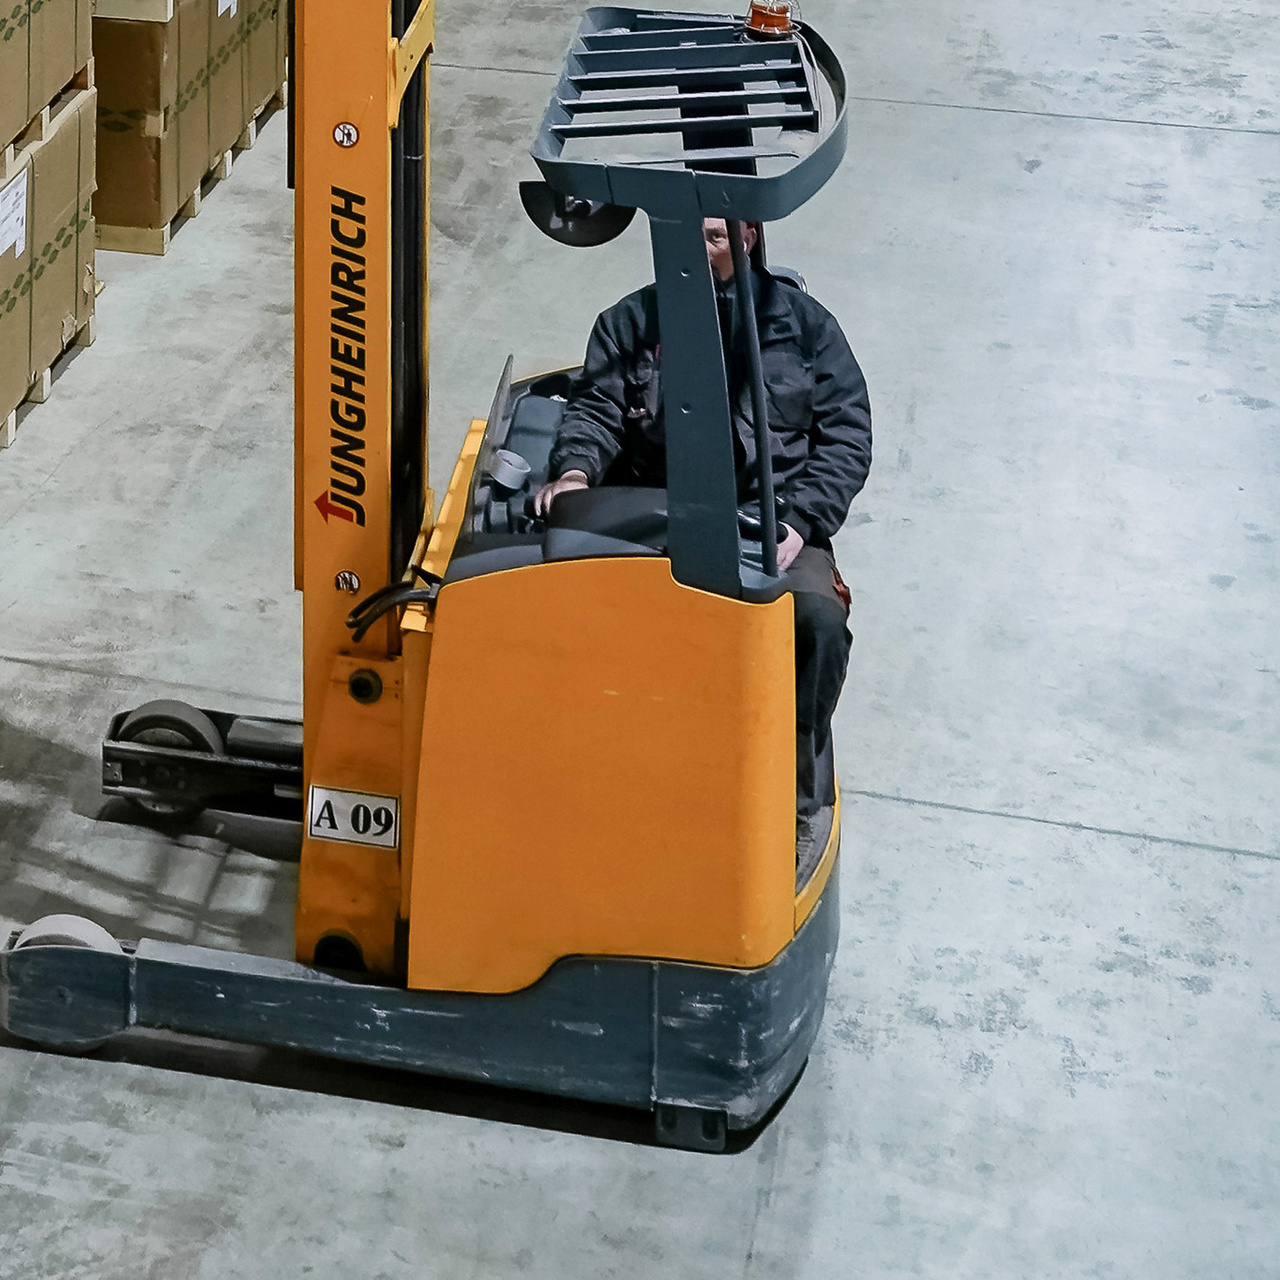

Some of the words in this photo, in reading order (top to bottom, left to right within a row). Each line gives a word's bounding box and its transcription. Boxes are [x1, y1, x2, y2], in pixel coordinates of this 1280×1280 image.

[330, 185, 367, 528] JUNGHEINRICH
[313, 799, 339, 831] A
[350, 803, 394, 837] 09
